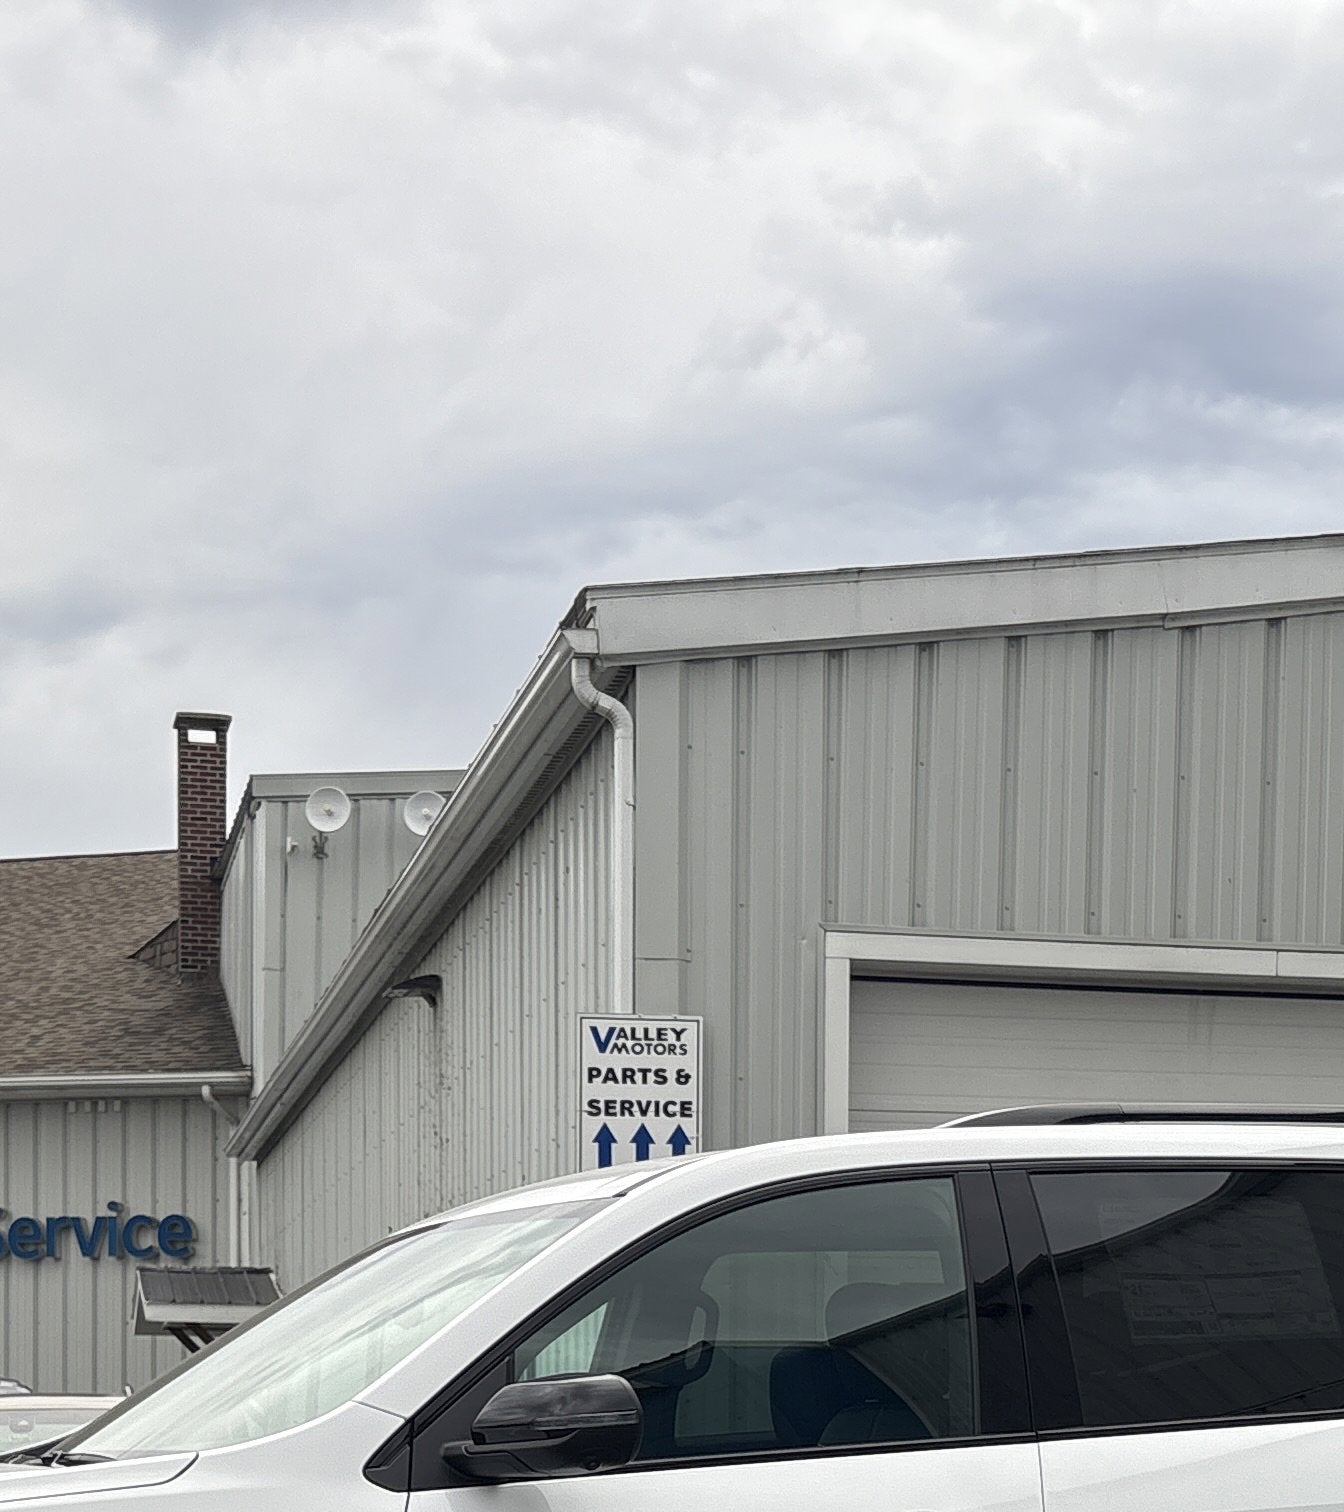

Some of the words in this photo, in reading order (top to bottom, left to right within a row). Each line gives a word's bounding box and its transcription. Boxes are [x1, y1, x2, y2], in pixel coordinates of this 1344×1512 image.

[589, 1025, 688, 1054] VALLEY
[609, 1042, 688, 1056] MOTORS
[587, 1067, 668, 1085] PARTS
[674, 1068, 692, 1086] &
[586, 1098, 693, 1119] SERVICE
